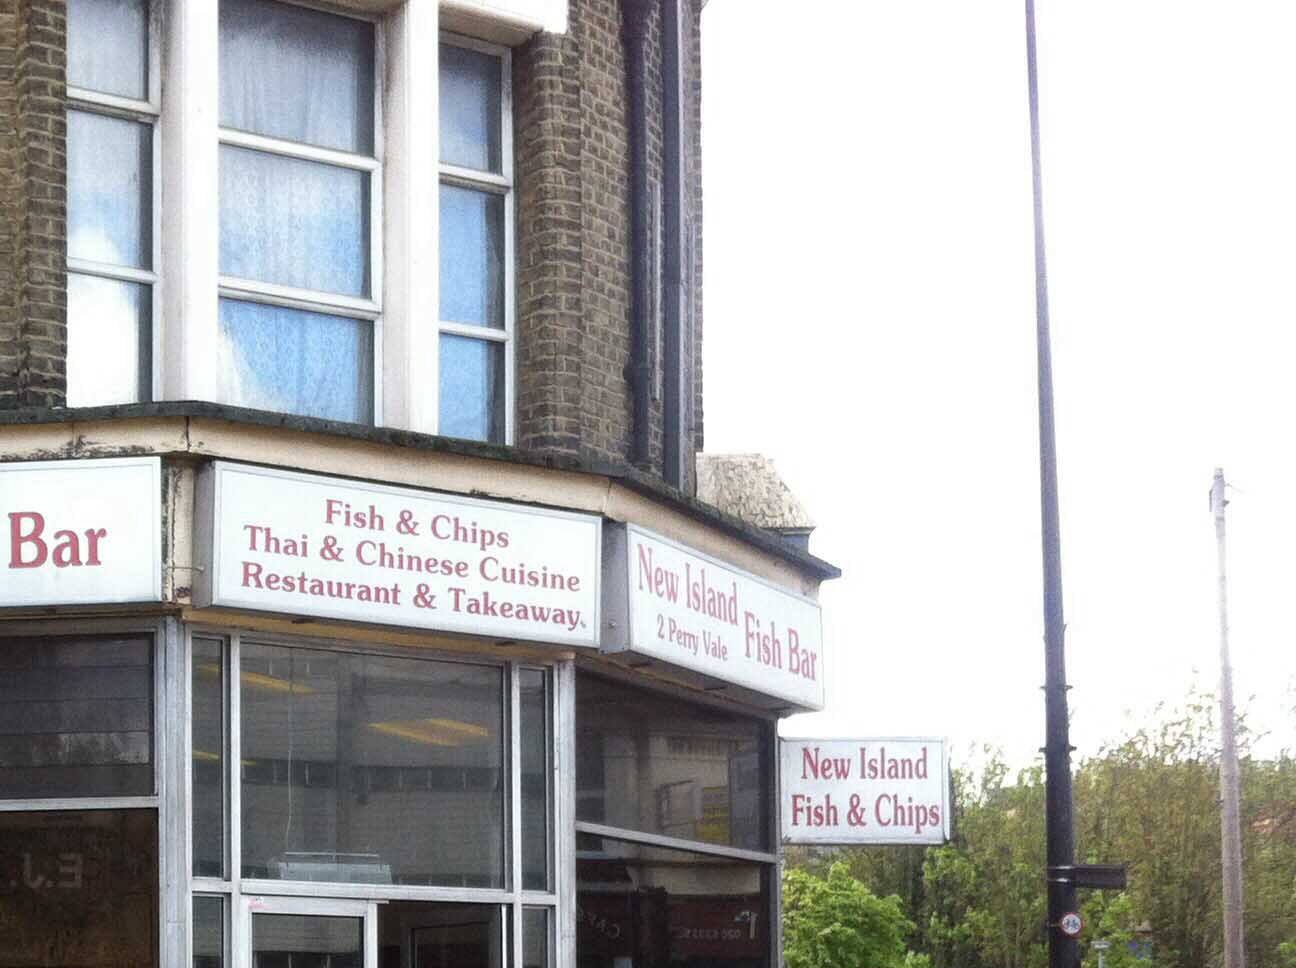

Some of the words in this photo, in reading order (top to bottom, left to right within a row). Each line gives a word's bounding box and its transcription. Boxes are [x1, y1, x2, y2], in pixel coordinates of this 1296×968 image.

[8, 510, 108, 570] Bar
[325, 498, 385, 532] Fish
[395, 509, 420, 536] &
[430, 514, 510, 551] Chips
[243, 524, 308, 558] Thai
[319, 535, 344, 562] &
[356, 540, 469, 577] Chinese
[479, 556, 581, 592] Cuisine
[240, 560, 401, 606] Restaurant
[412, 583, 437, 610] &
[447, 586, 582, 631] Takeaway
[637, 543, 679, 604] New
[685, 562, 739, 626] Island
[744, 610, 782, 670] Fish
[787, 627, 817, 681] Bar
[657, 613, 665, 640] 2
[668, 617, 699, 656] Perry
[702, 629, 729, 662] Vale
[800, 746, 851, 780] New
[859, 746, 928, 780] Island
[791, 793, 839, 827] Fish
[846, 793, 867, 826] &
[874, 793, 941, 834] Chips
